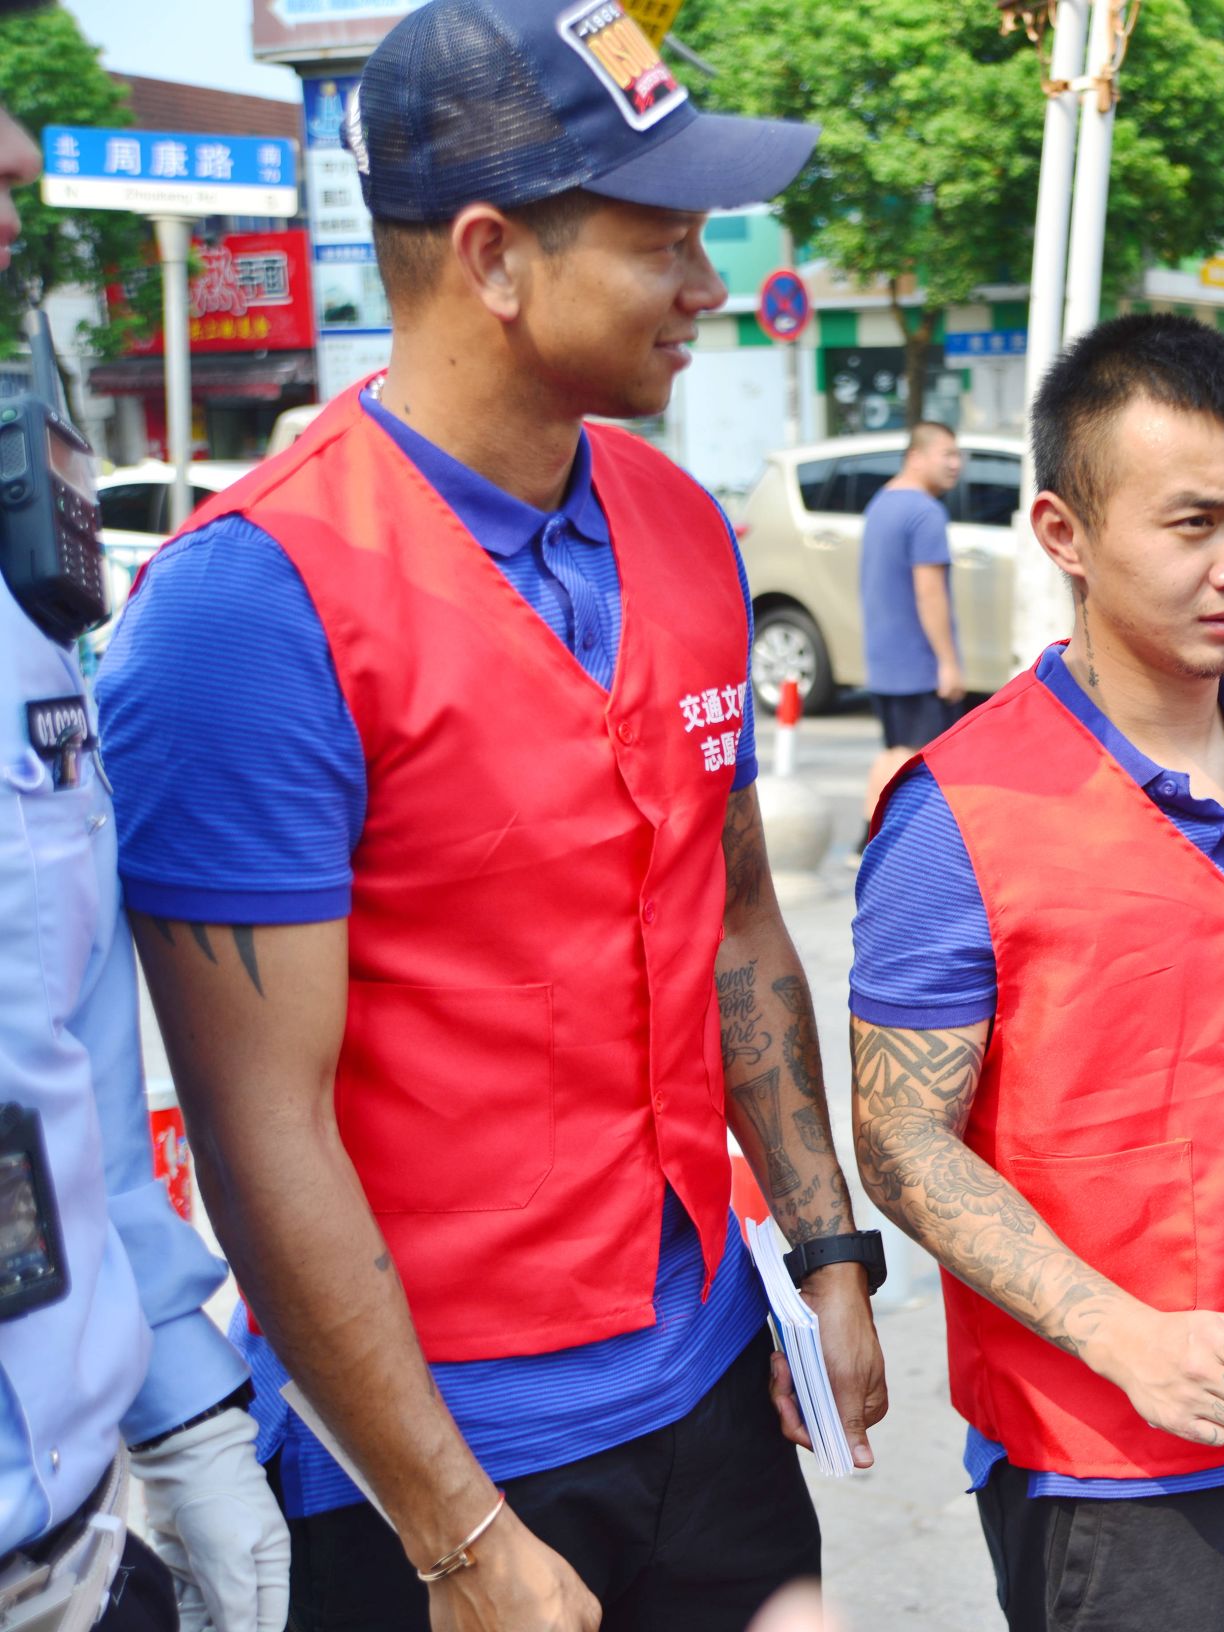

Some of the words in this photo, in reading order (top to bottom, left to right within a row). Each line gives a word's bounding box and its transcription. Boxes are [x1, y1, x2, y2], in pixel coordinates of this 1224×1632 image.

[104, 138, 234, 181] 周康路
[700, 728, 742, 772] 志愿
